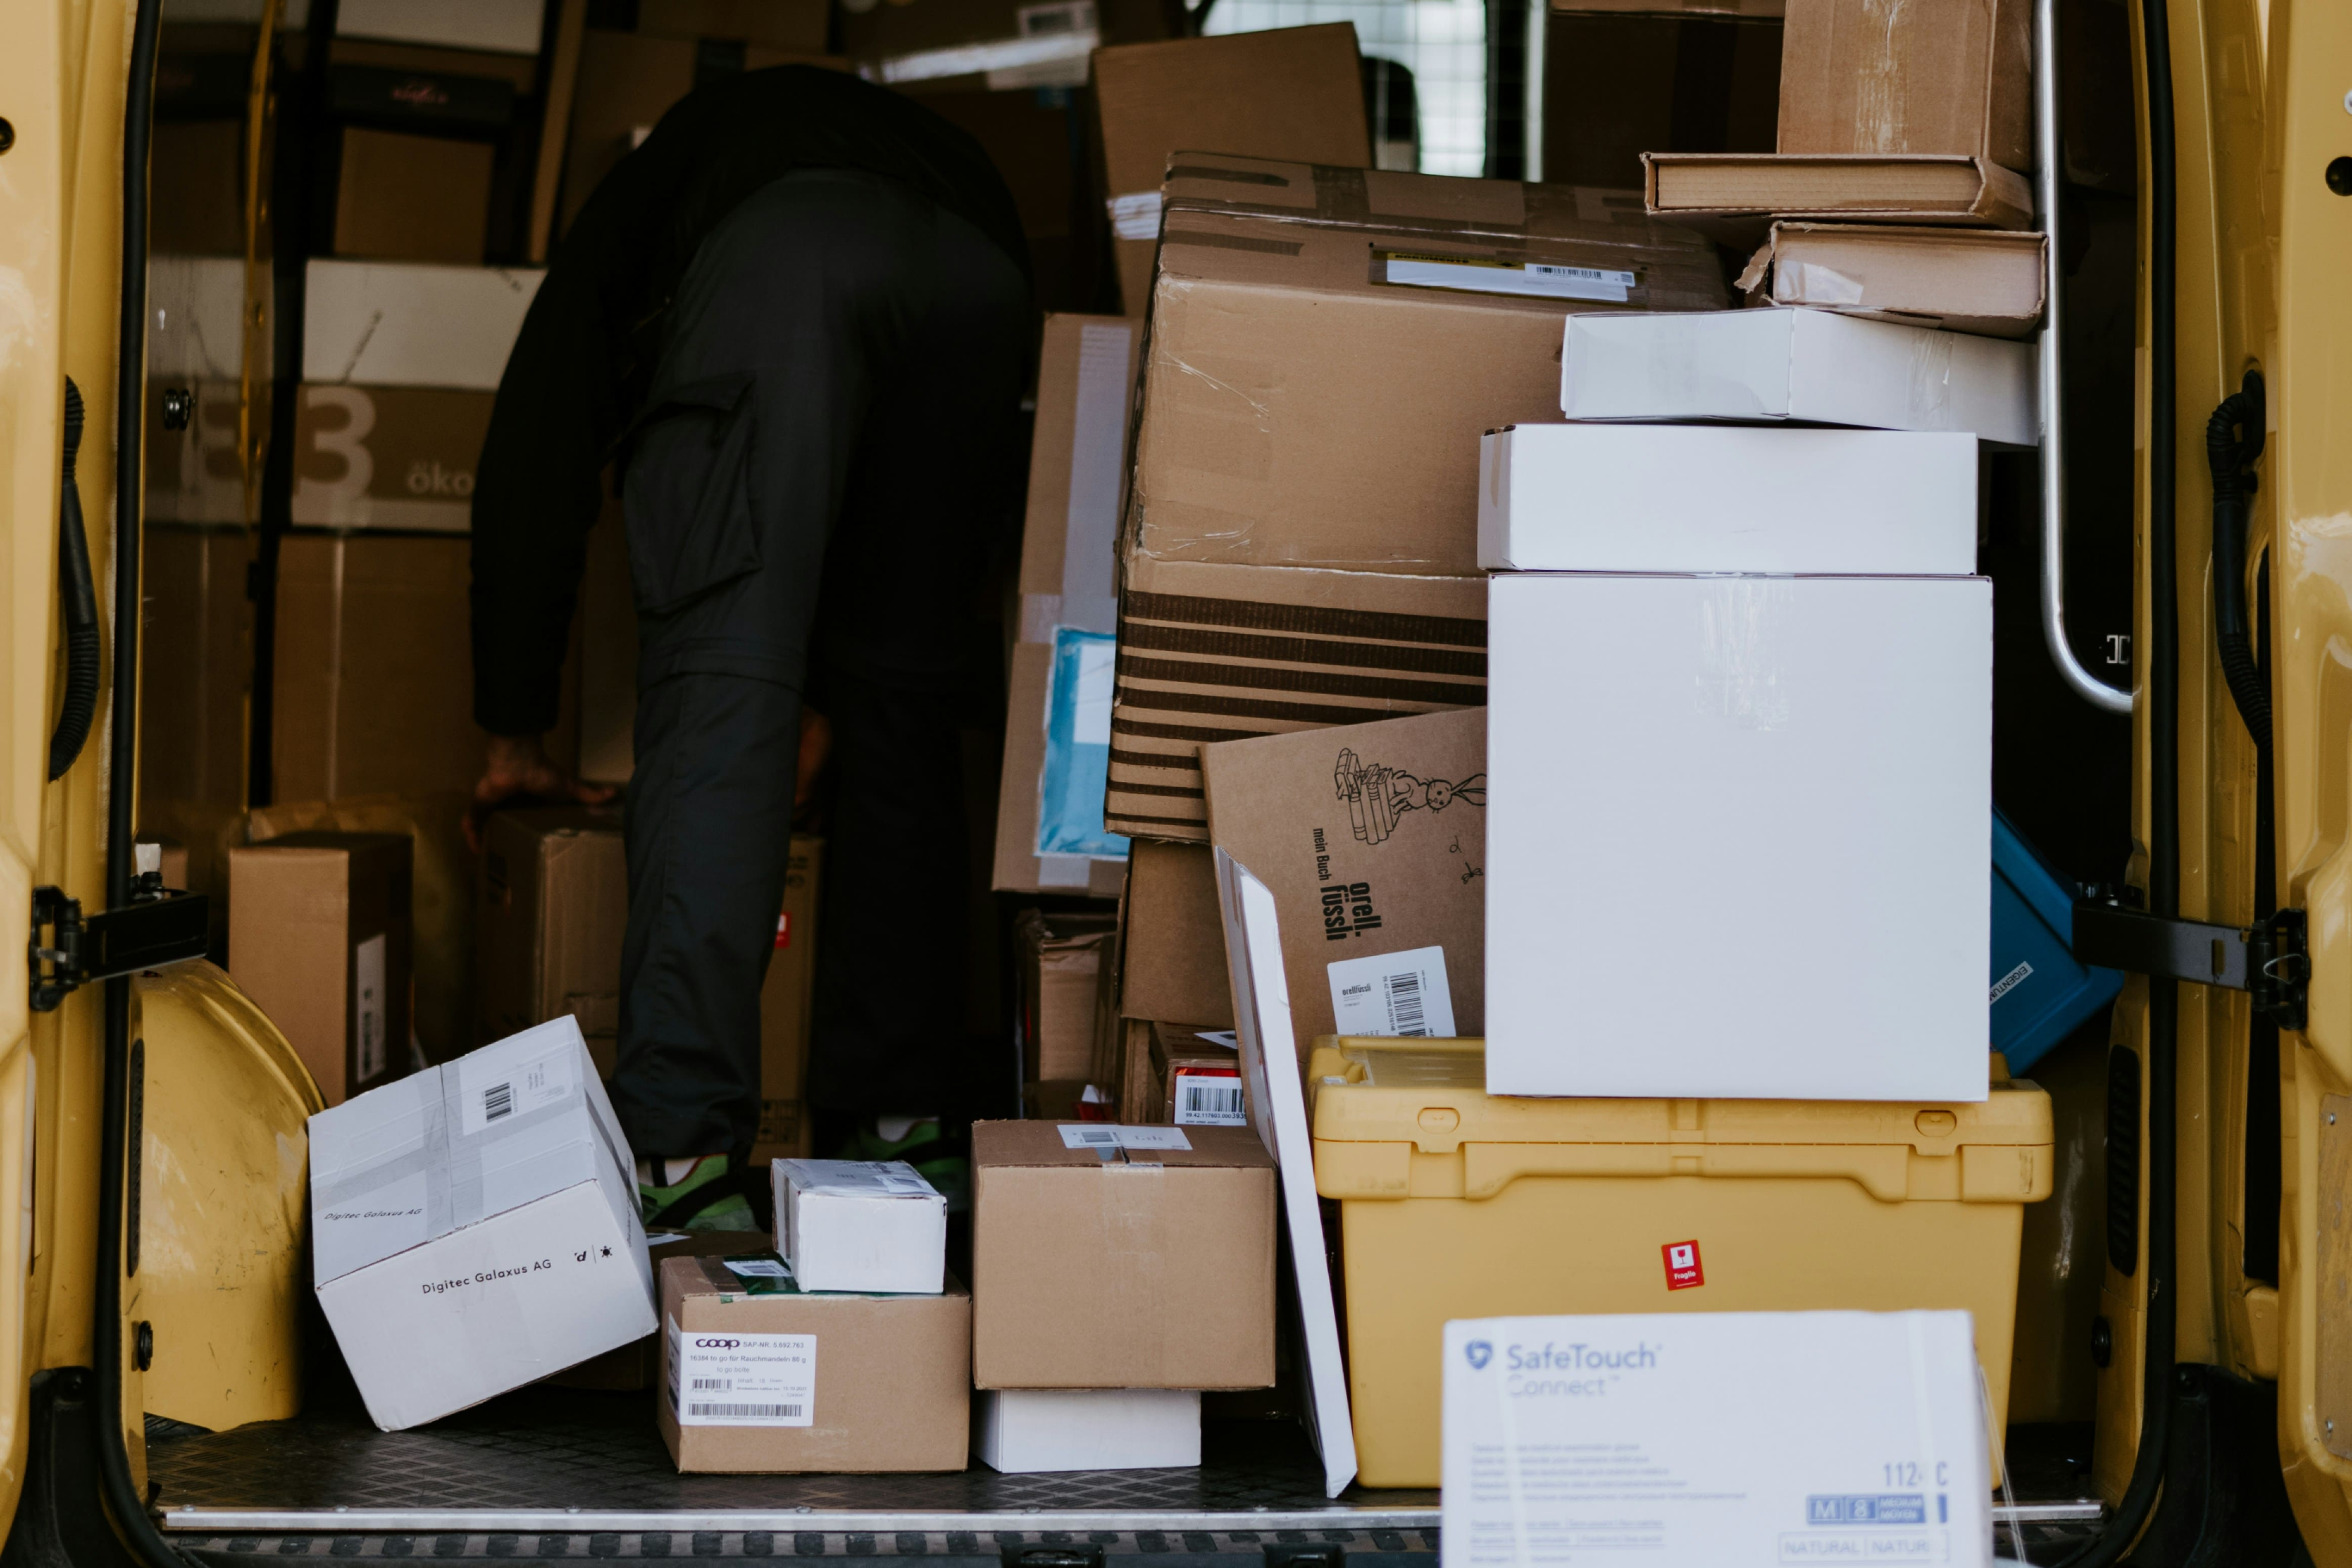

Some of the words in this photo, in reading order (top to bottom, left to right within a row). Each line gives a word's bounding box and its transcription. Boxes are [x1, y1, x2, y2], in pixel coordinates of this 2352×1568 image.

[1313, 828, 1326, 853] mein
[1317, 855, 1332, 881] Buch
[1321, 885, 1353, 940] füssli
[1349, 882, 1382, 937] orell.
[324, 1210, 361, 1221] Digitec
[364, 1210, 404, 1218] Galaxus
[421, 1275, 470, 1295] Digitec
[475, 1263, 528, 1283] Galaxus
[533, 1259, 552, 1271] AG
[1674, 1271, 1696, 1280] Fragile
[695, 1338, 740, 1351] coop
[1814, 1499, 1837, 1519] M
[1853, 1499, 1868, 1518] 8
[1784, 1540, 1860, 1555] NATURAL
